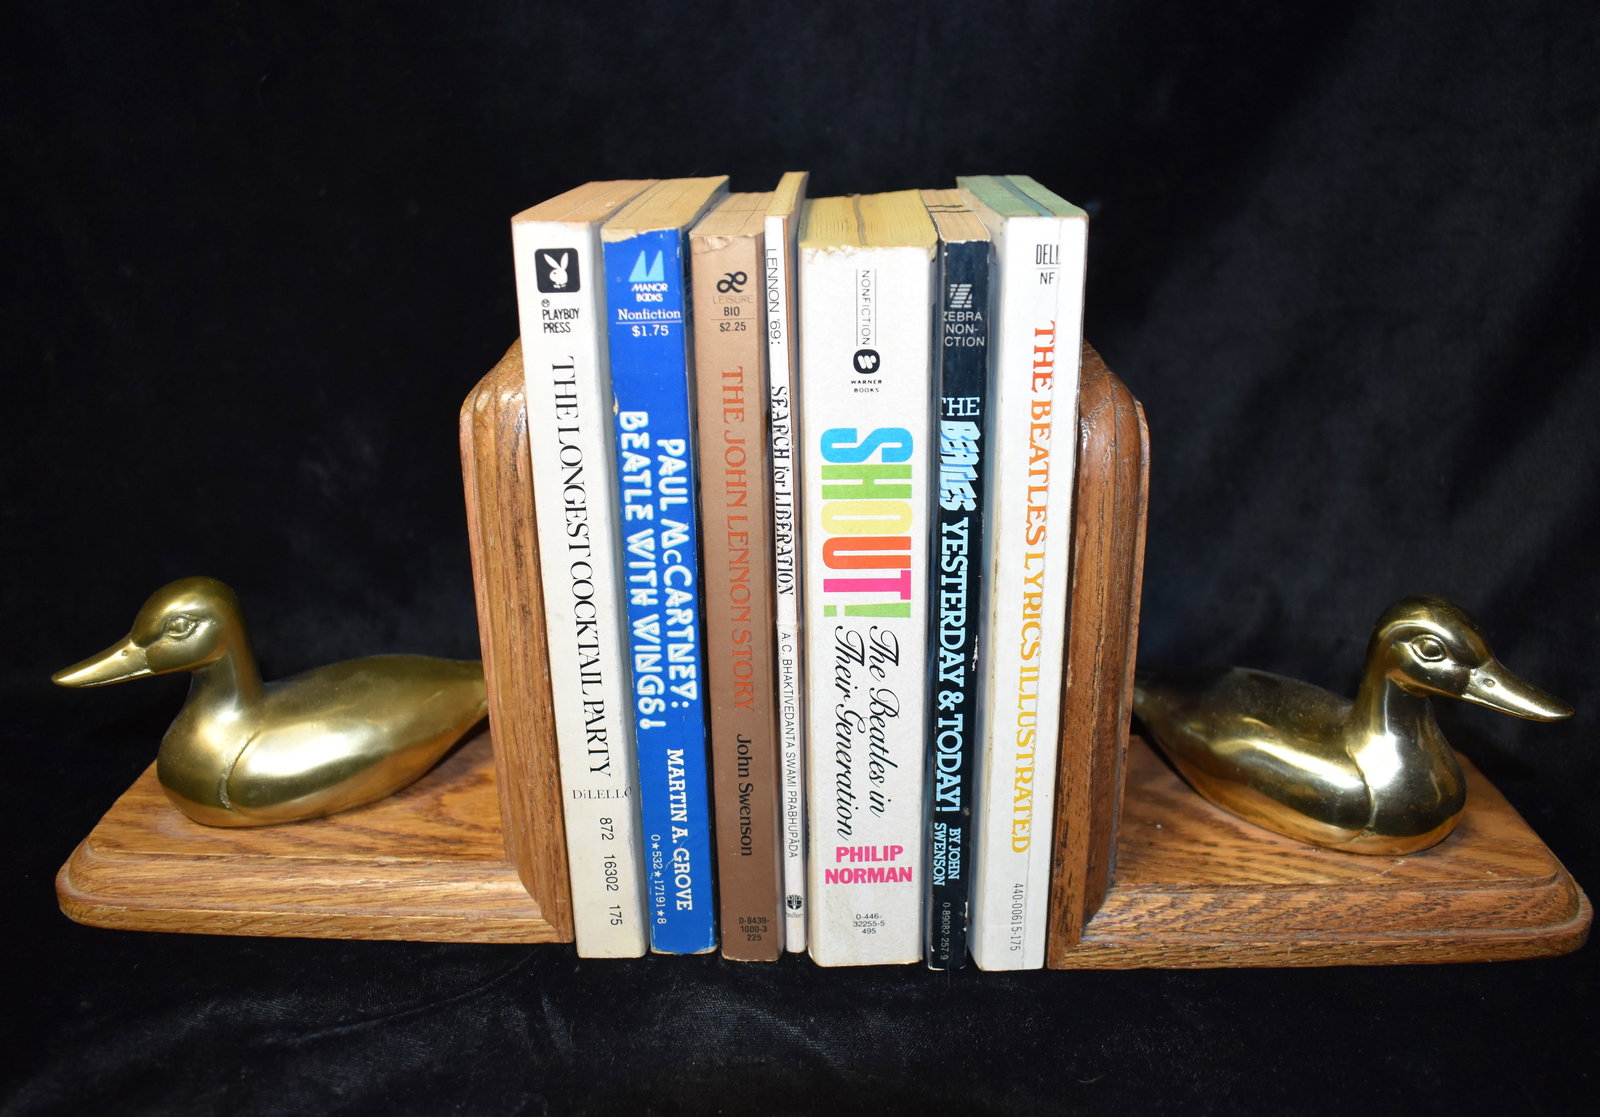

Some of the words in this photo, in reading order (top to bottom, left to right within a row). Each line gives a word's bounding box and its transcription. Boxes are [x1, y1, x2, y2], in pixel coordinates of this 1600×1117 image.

[766, 248, 780, 312] LENNON
[1035, 244, 1062, 265] DELL
[1040, 272, 1055, 284] NF
[543, 308, 579, 320] PLAYBOY
[618, 309, 681, 320] Nonfiction
[631, 283, 669, 292] MANOR
[636, 293, 663, 302] BOOKS
[712, 295, 754, 304] LEISURE
[724, 307, 740, 316] BIO
[861, 270, 871, 345] NONFICTION
[543, 322, 571, 333] PRESS
[632, 325, 669, 336] $1.75
[720, 322, 746, 332] $2.25
[946, 324, 978, 334] NON-
[1031, 320, 1056, 392] THE
[552, 356, 577, 422] THE
[721, 367, 744, 423] THE
[771, 386, 789, 461] SEARCH
[558, 425, 591, 558] LONGEST
[620, 411, 654, 521] BEATLE
[657, 439, 689, 515] PAUL
[724, 429, 749, 509] JOHN
[774, 465, 788, 488] for
[1025, 400, 1052, 546] BEATLES
[773, 488, 795, 596] LIBERATION
[820, 427, 913, 618] SHOUT!
[627, 526, 658, 604] WITH
[726, 515, 754, 629] LENNON
[571, 559, 599, 699] COCKTAIL
[940, 517, 969, 688] YESTERDAY
[1020, 552, 1045, 661] LYRICS
[635, 613, 667, 730] WINGS!
[730, 631, 755, 711] STORY
[834, 625, 865, 703] Their
[868, 625, 900, 682] The
[782, 658, 796, 749] BHAKTIVEDANTA
[938, 690, 965, 710] &
[584, 700, 611, 777] PARTY
[736, 734, 754, 779] John
[869, 679, 900, 787] Beatles
[1011, 666, 1039, 853] ILLUSTRATED
[667, 748, 688, 823] MARTIN
[784, 751, 796, 788] SWAMI
[834, 701, 865, 842] Generation
[936, 714, 962, 813] TODAY!
[600, 818, 614, 840] 872
[736, 783, 754, 857] Swenson
[869, 785, 893, 820] in
[672, 826, 687, 844] A.
[835, 845, 904, 863] PHILIP
[933, 823, 947, 886] SWENSON
[948, 828, 961, 844] BY
[948, 846, 960, 879] JOHN
[604, 854, 618, 892] 16302
[672, 846, 693, 911] GROVE
[824, 866, 913, 885] NORMAN
[609, 905, 622, 926] 175
[738, 917, 770, 925] 0-8439-
[740, 925, 768, 933] 1000-3
[746, 933, 763, 941] 225
[852, 920, 885, 928] 32255-5
[861, 927, 876, 935] 495
